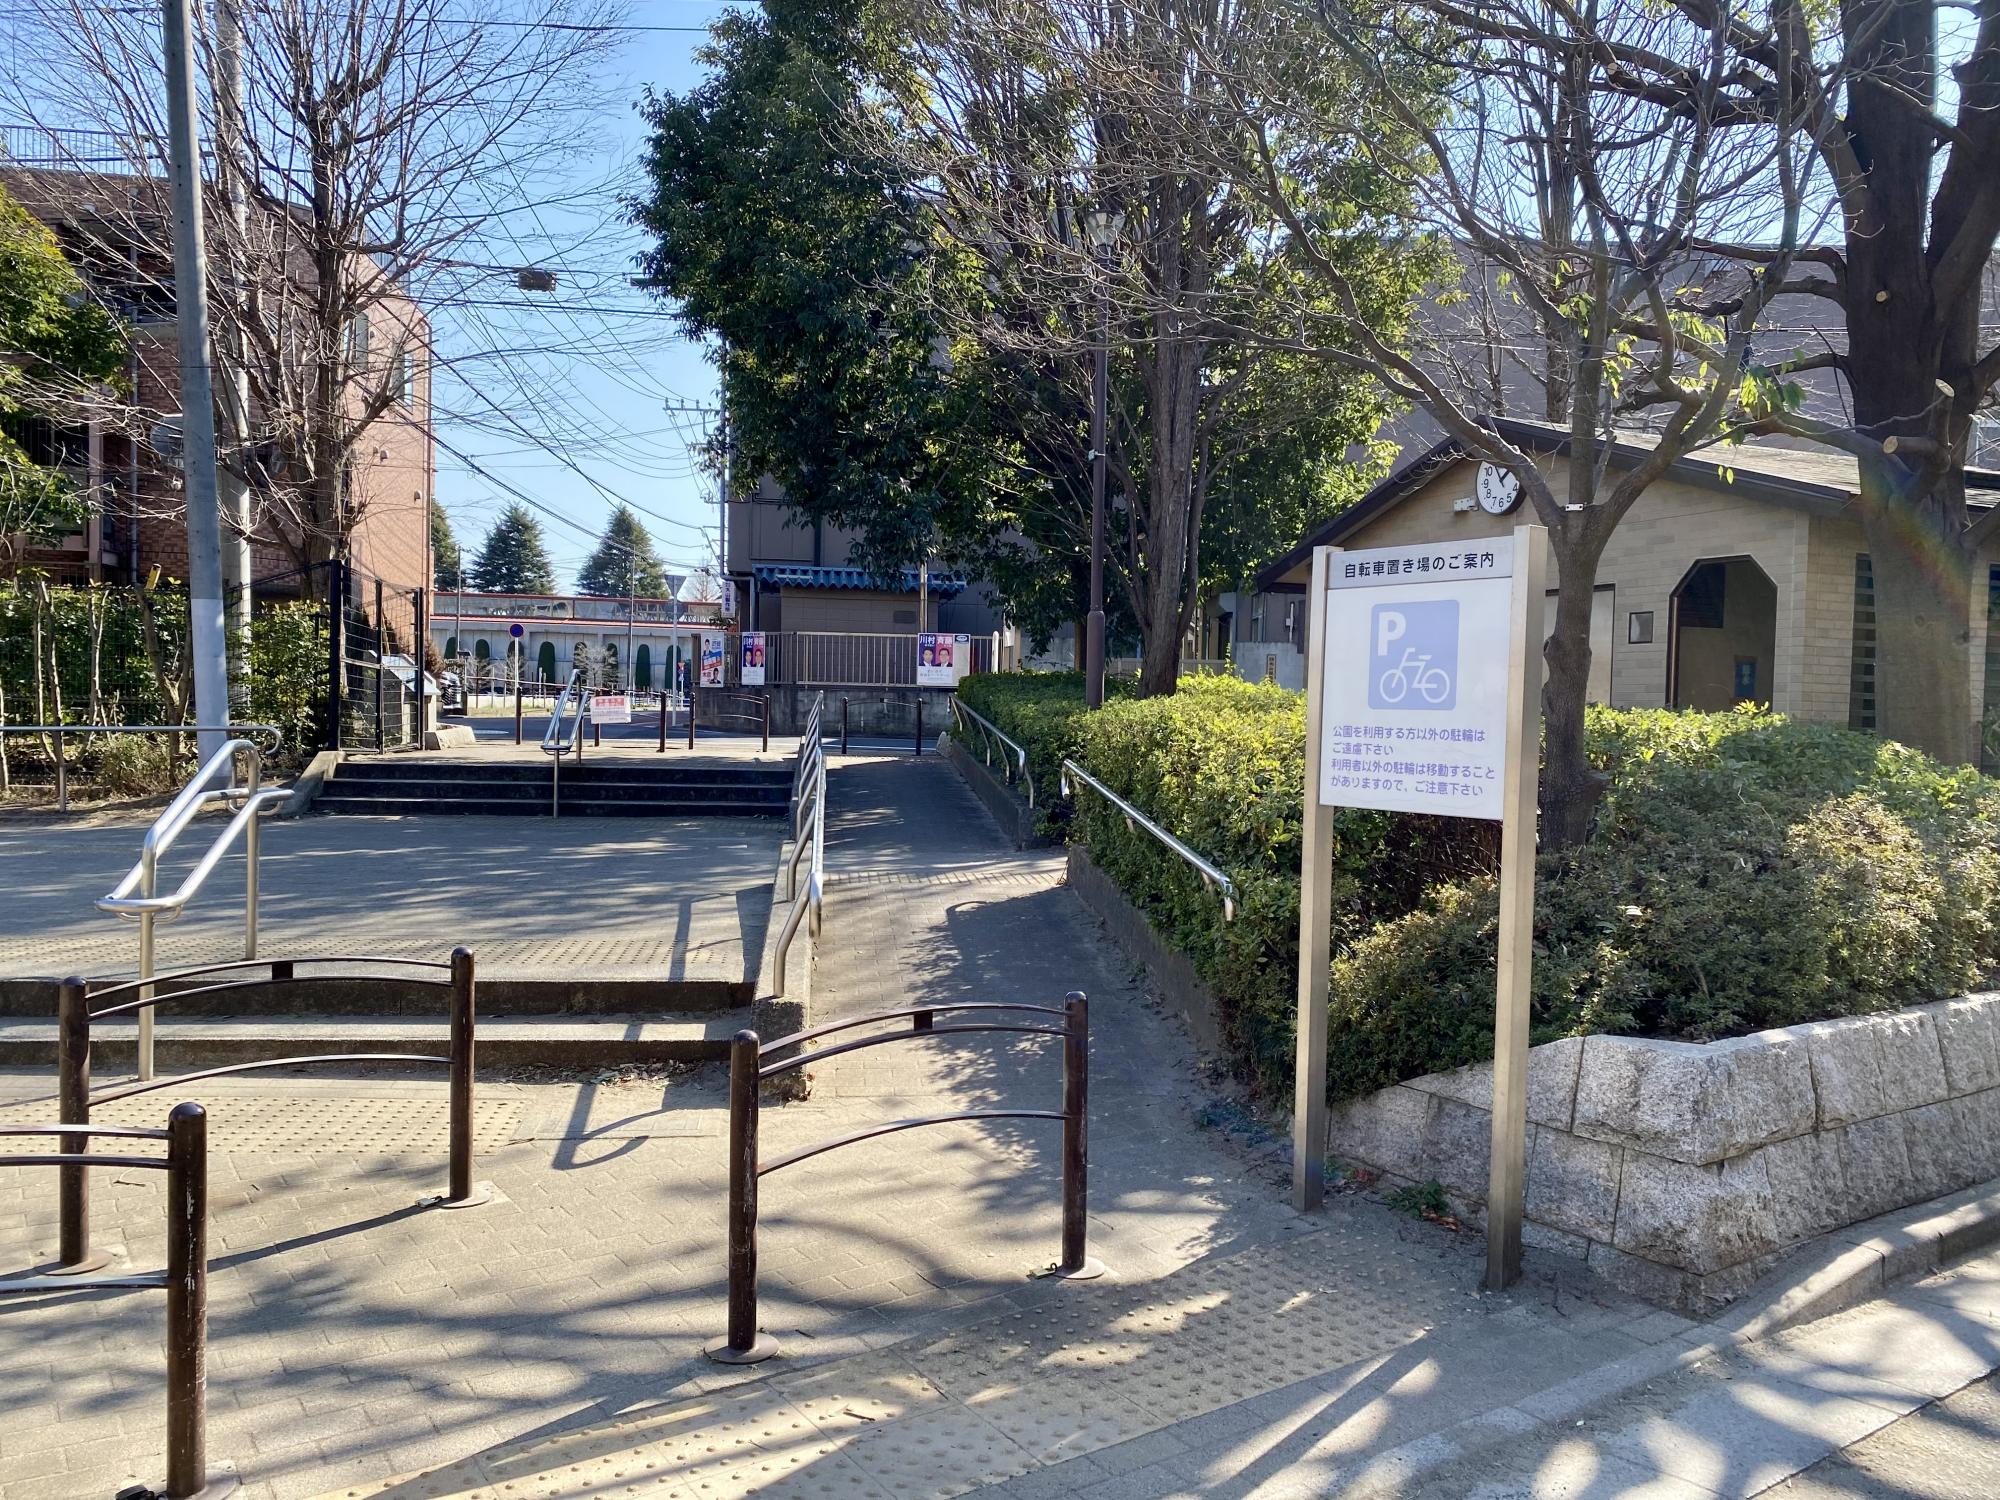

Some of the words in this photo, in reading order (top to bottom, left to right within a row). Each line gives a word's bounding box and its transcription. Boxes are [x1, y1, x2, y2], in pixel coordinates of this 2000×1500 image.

[1484, 466, 1492, 476] 10
[1484, 478, 1488, 488] 9
[1512, 482, 1518, 493] 4
[1486, 488, 1492, 498] 8
[1506, 492, 1512, 503] 5
[1492, 496, 1497, 506] 7
[1498, 498, 1504, 508] 6
[1344, 551, 1494, 578] 自転車置き場のご案内
[1377, 611, 1407, 656] P
[1332, 725, 1485, 742] 公園を利用する方以外の駐輪は
[1332, 742, 1394, 756] ご遠慮下さい
[1331, 758, 1495, 779] 利用者以外の駐輪は移動すること
[1331, 775, 1483, 796] がありますので、ご注意下さい
